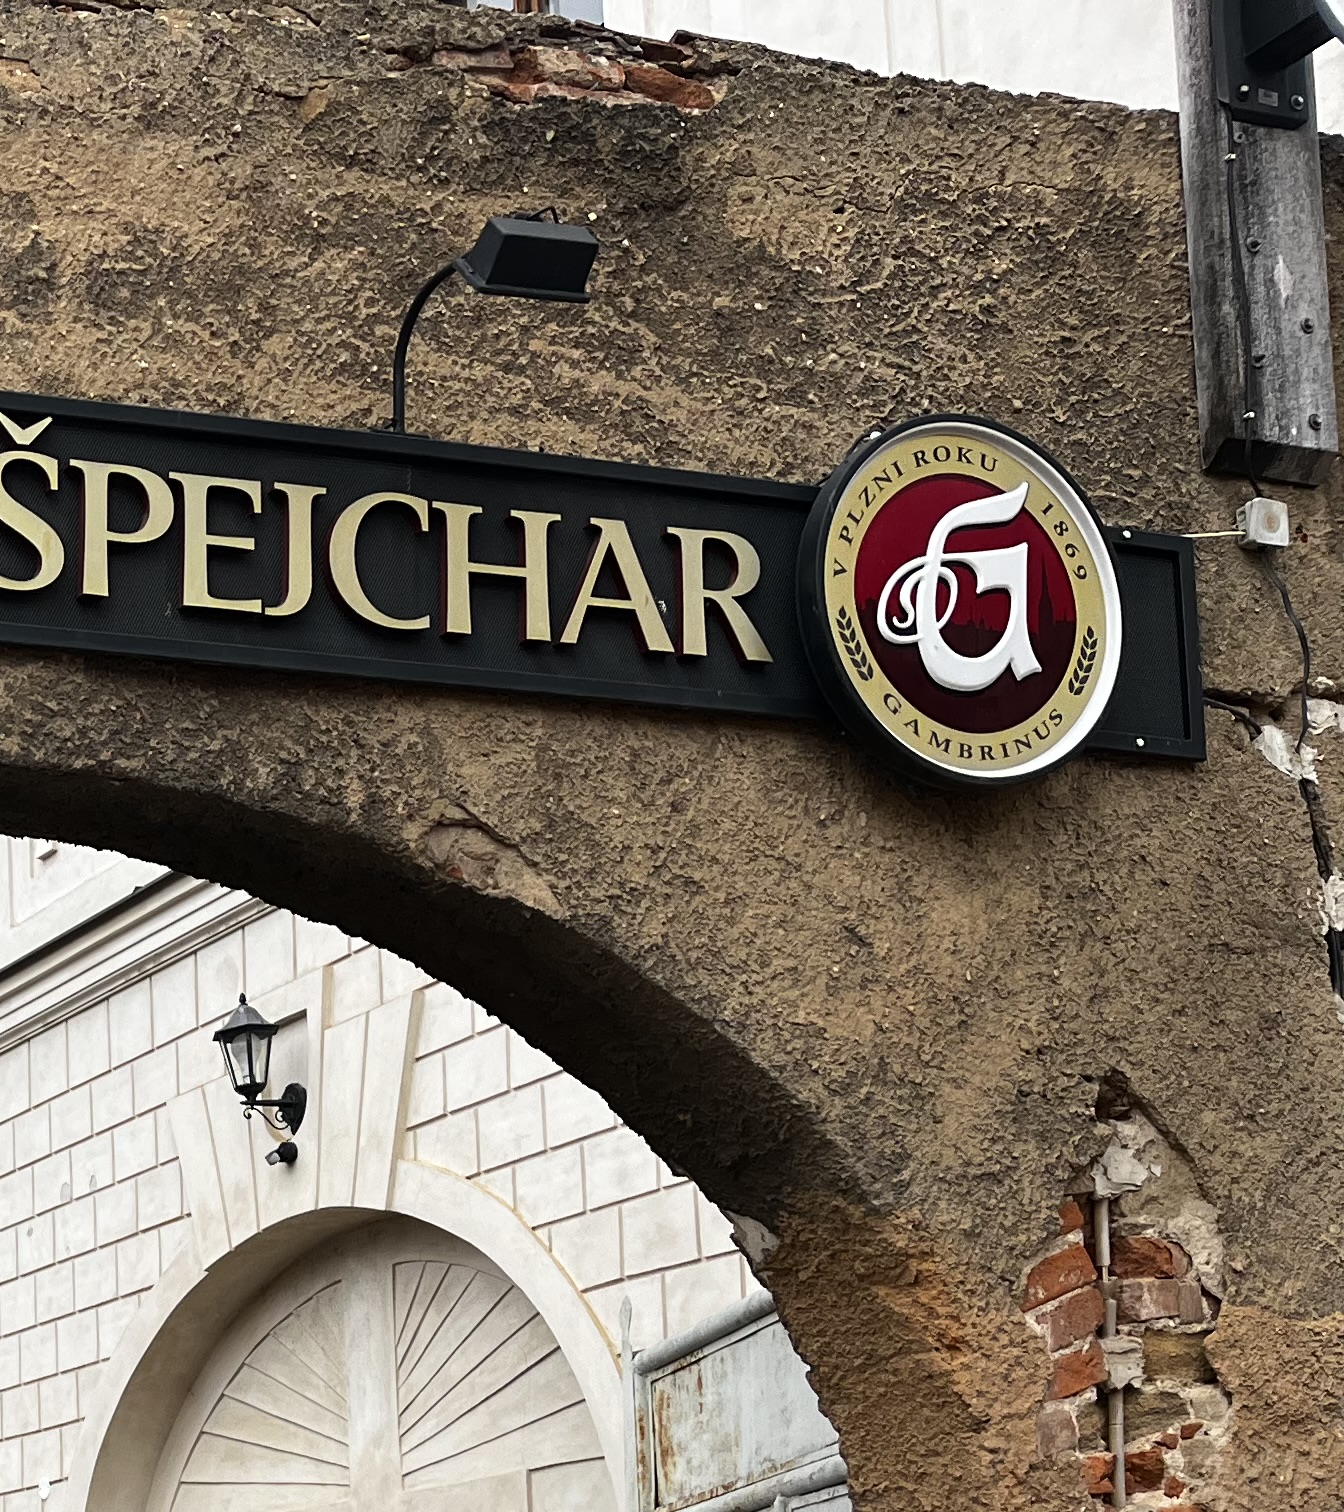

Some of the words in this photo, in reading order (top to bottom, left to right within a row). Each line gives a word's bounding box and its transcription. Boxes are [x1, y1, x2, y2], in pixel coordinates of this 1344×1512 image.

[912, 445, 999, 473] ROKU
[839, 459, 907, 547] PLZNI
[832, 557, 848, 579] V
[1039, 501, 1089, 581] 1869
[882, 692, 1064, 762] GAMBRINUS
